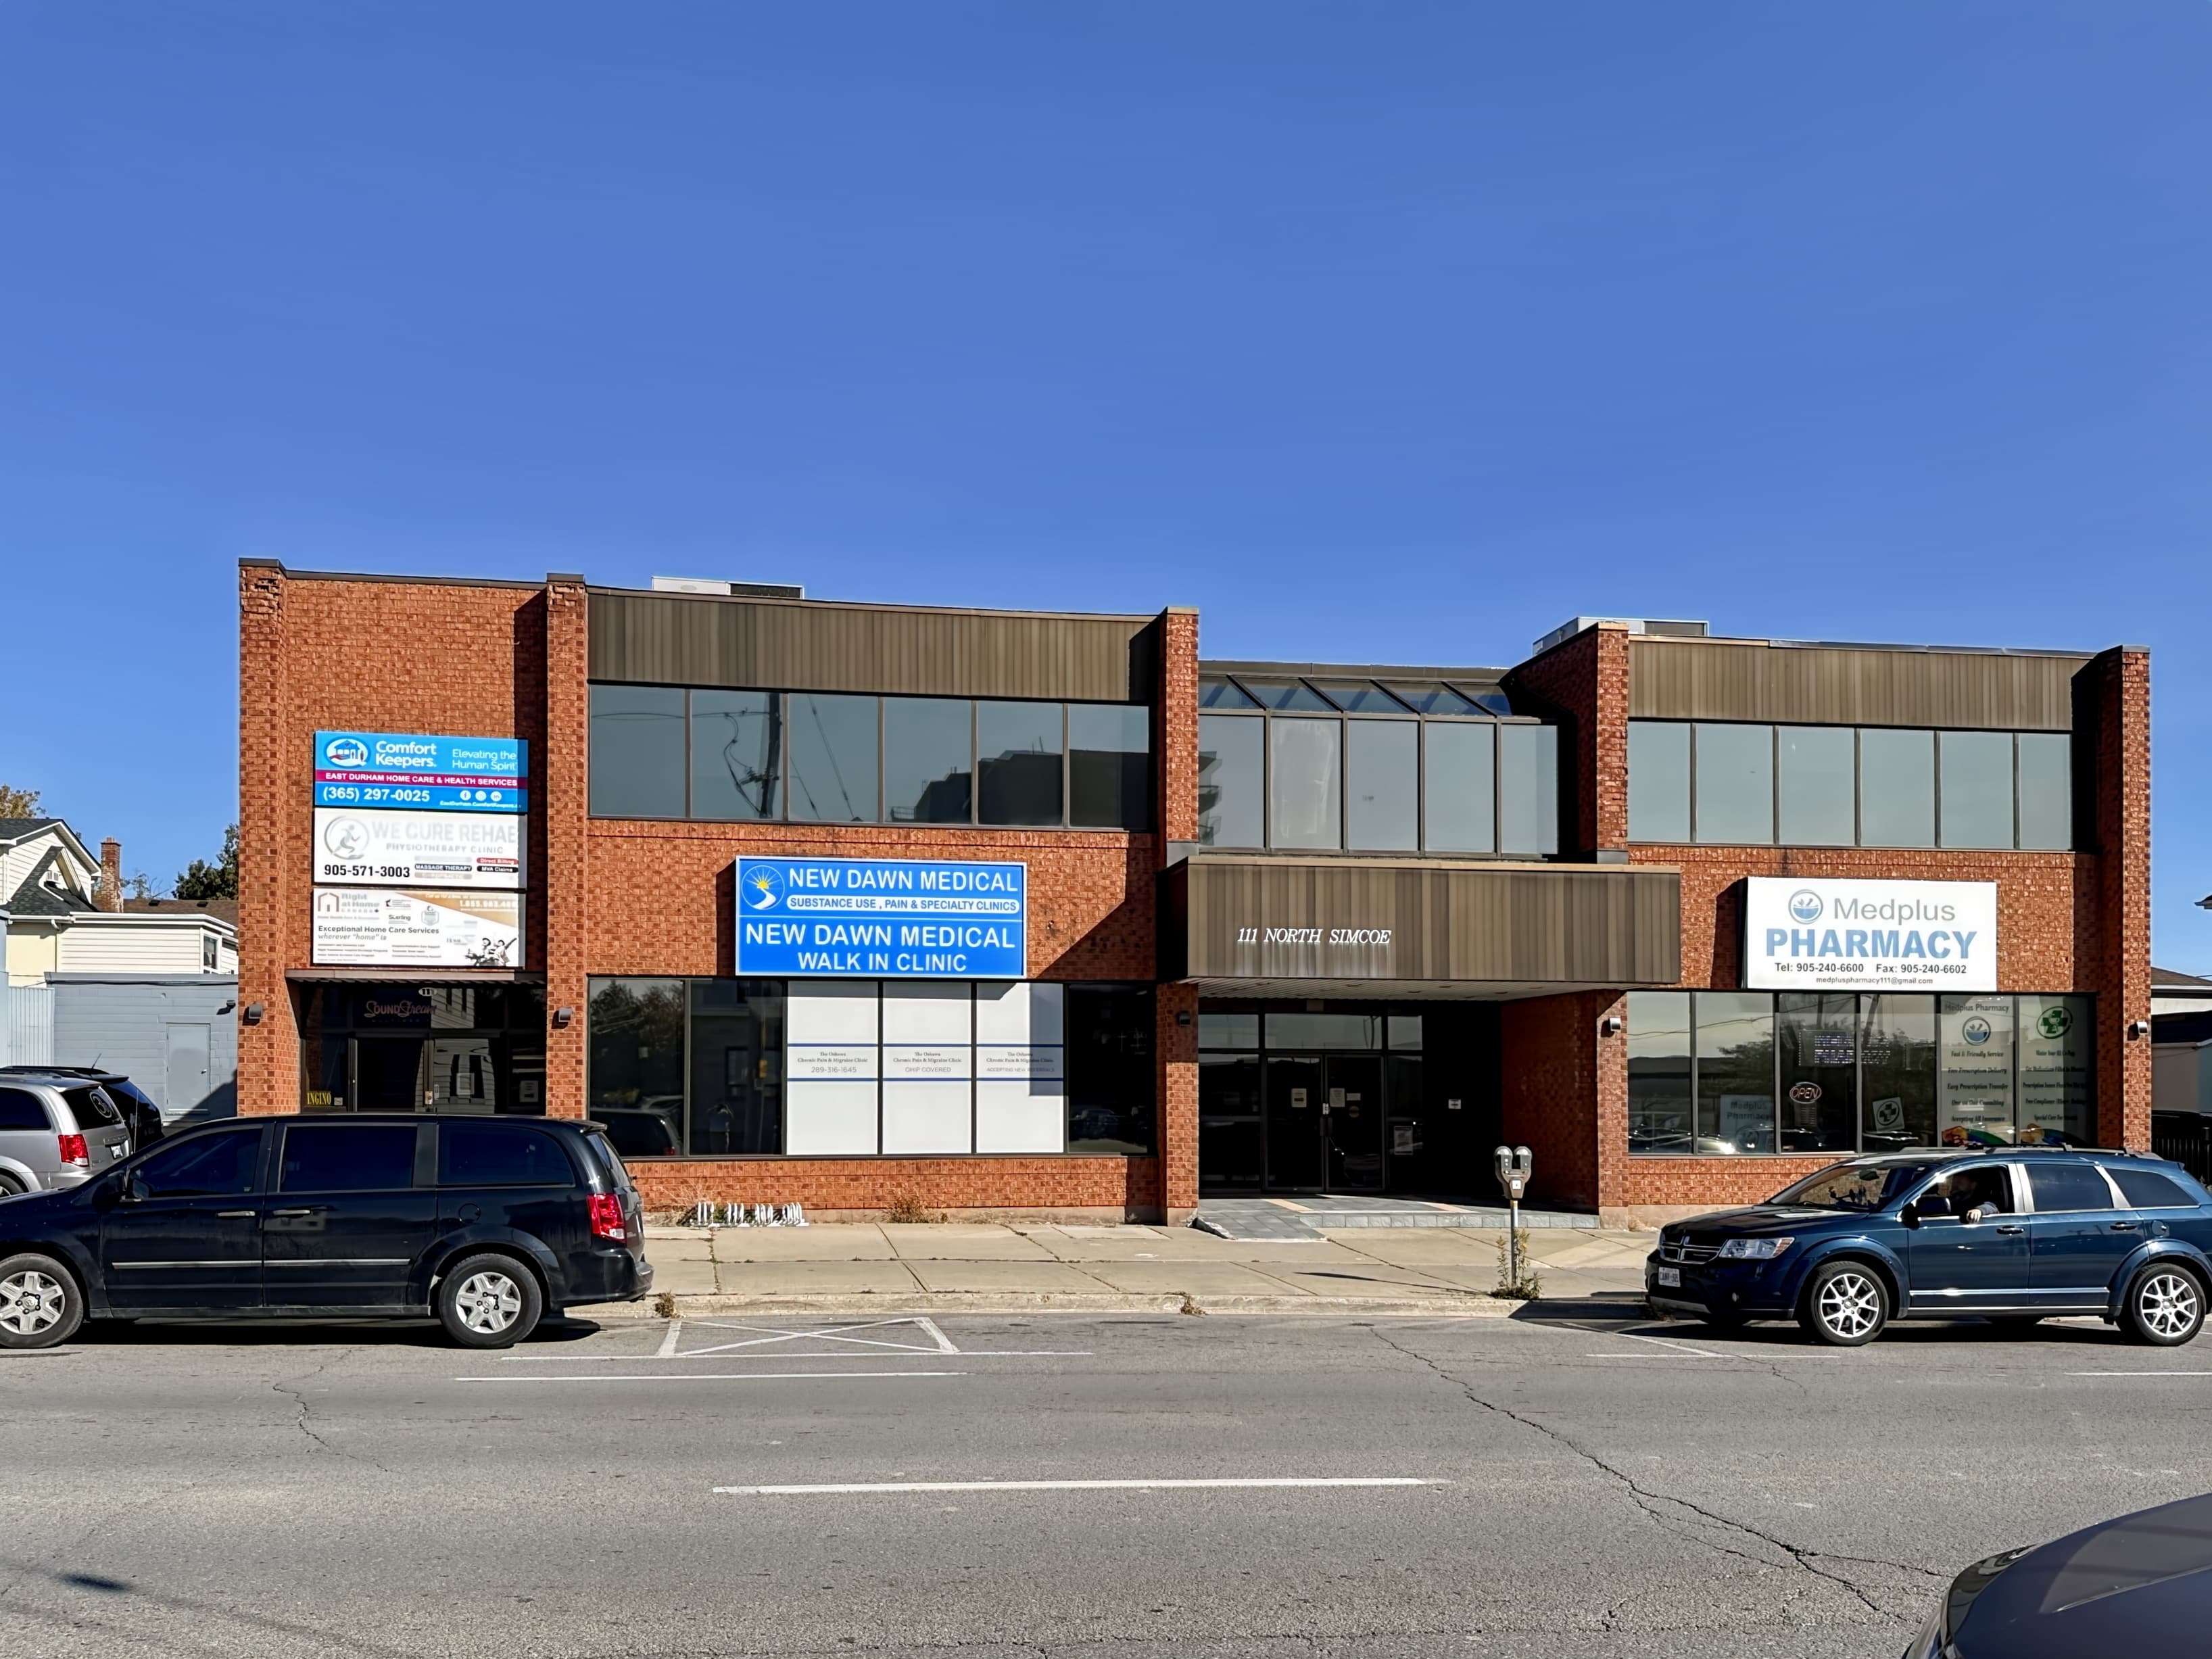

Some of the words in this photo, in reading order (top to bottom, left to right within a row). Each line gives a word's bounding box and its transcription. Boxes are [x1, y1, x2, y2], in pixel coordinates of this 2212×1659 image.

[376, 741, 437, 754] Comfort
[452, 749, 498, 761] Elevating
[500, 750, 516, 760] the
[452, 760, 489, 769] Human
[349, 773, 384, 782] DURHAM
[387, 774, 410, 782] HOME
[412, 775, 434, 783] CARE
[478, 778, 517, 786] SERVICES
[323, 786, 360, 802] (365)
[364, 788, 431, 802] 297-0025
[372, 821, 401, 840] WE
[406, 822, 454, 841] CURE
[386, 843, 466, 852] PHYSIOTHERAPY
[324, 865, 410, 877] 905-571-3003
[789, 868, 840, 888] NEW
[848, 869, 912, 890] DAWN
[920, 871, 1018, 892] MEDICAL
[790, 897, 852, 908] SUBSTANCE
[885, 900, 908, 909] PAIN
[911, 900, 918, 909] &
[921, 900, 973, 911] SPECIALTY
[977, 901, 1017, 911] CLINICS
[1833, 898, 1956, 925] Medplus
[746, 923, 806, 944] NEW
[815, 924, 892, 946] DAWN
[902, 926, 1015, 948] MEDICAL
[1238, 928, 1257, 942] 111
[1264, 928, 1323, 943] NORTH
[1329, 929, 1392, 944] SIMCOE
[1766, 928, 1977, 959] PHARMACY
[798, 952, 861, 971] WALK
[869, 953, 888, 971] IN
[897, 953, 967, 972] CLINIC
[1775, 963, 1793, 972] Tel:
[1796, 963, 1864, 973] 905-240-6600
[1875, 963, 1898, 973] Fax:
[1900, 963, 1967, 974] 905-240-6602
[1816, 976, 1933, 985] medpluspharmacy111@gmail.com
[1975, 1003, 2010, 1013] Pharmacy
[1792, 1087, 1819, 1099] OPEN
